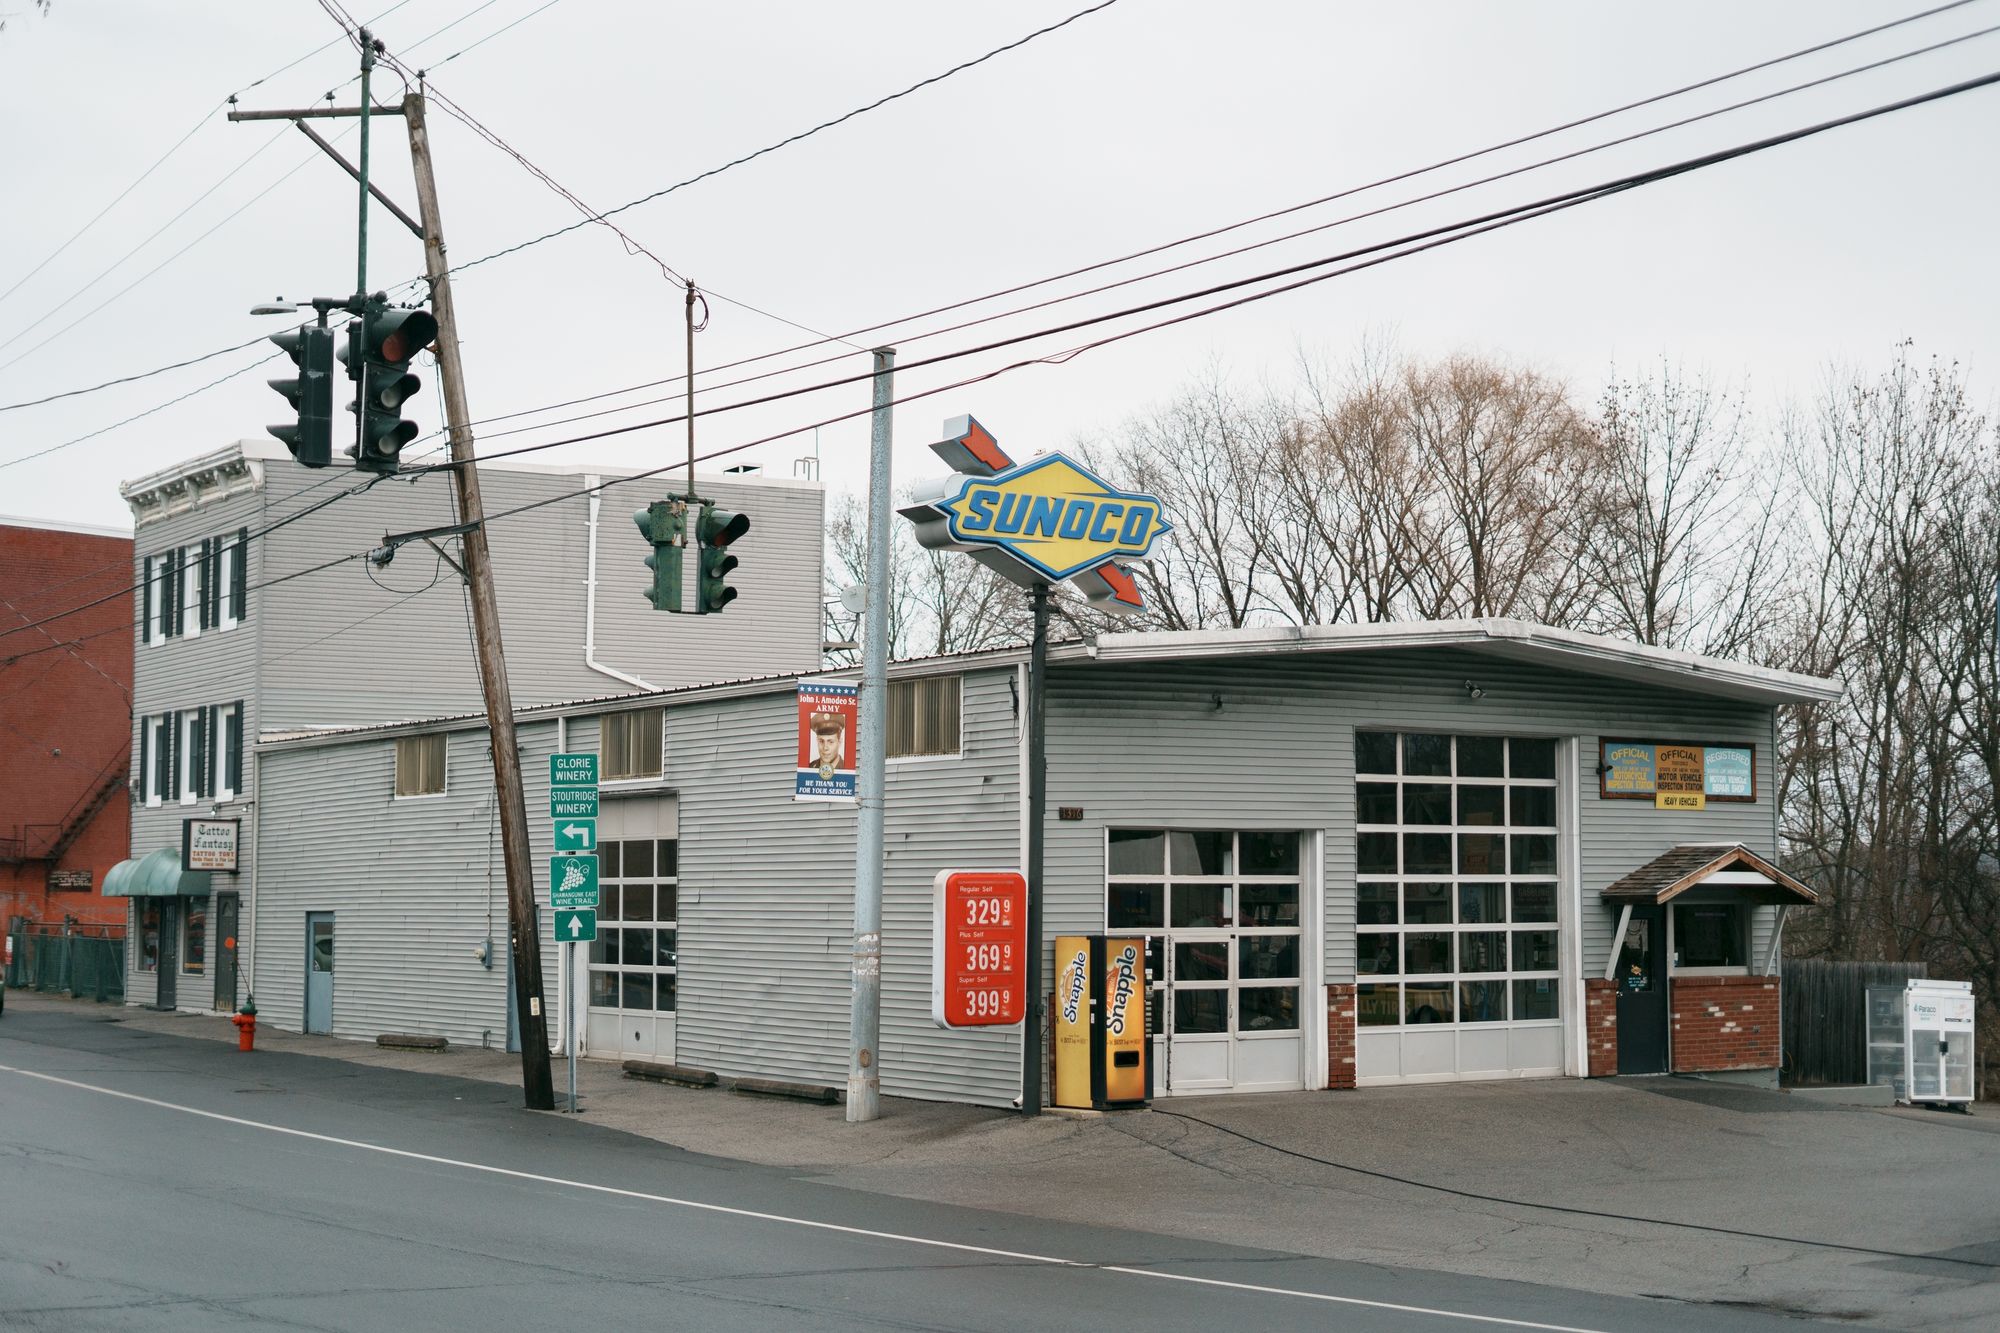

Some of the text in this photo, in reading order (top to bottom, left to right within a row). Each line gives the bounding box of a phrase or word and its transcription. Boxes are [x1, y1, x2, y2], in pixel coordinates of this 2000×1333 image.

[962, 489, 1155, 546] SUNOCO
[800, 694, 814, 703] John
[821, 696, 847, 705] Amodeo
[816, 704, 840, 712] ARMY
[1611, 747, 1650, 762] OFFICIAL
[1660, 749, 1698, 764] OFFICIAL
[1705, 751, 1750, 766] REGISTERED
[557, 758, 591, 768] GLORIE
[555, 770, 593, 780] WINERY
[1658, 772, 1702, 782] MOTOR VEHICLE
[1709, 775, 1747, 784] MOTOR VEHICLE
[1658, 782, 1703, 791] INSPECTION STATION
[552, 791, 597, 801] STOUTRIDGE
[1664, 797, 1698, 806] HEAVY VEHICLES
[555, 803, 593, 814] WINERY
[198, 824, 230, 836] Tattoo
[194, 837, 234, 851] Fantasy
[959, 886, 980, 894] Regular
[966, 898, 1001, 925] 329
[966, 944, 1001, 971] 369
[959, 976, 975, 984] Super
[1063, 951, 1087, 1024] Snapple
[1105, 945, 1138, 1036] Snapple
[966, 990, 1000, 1016] 399
